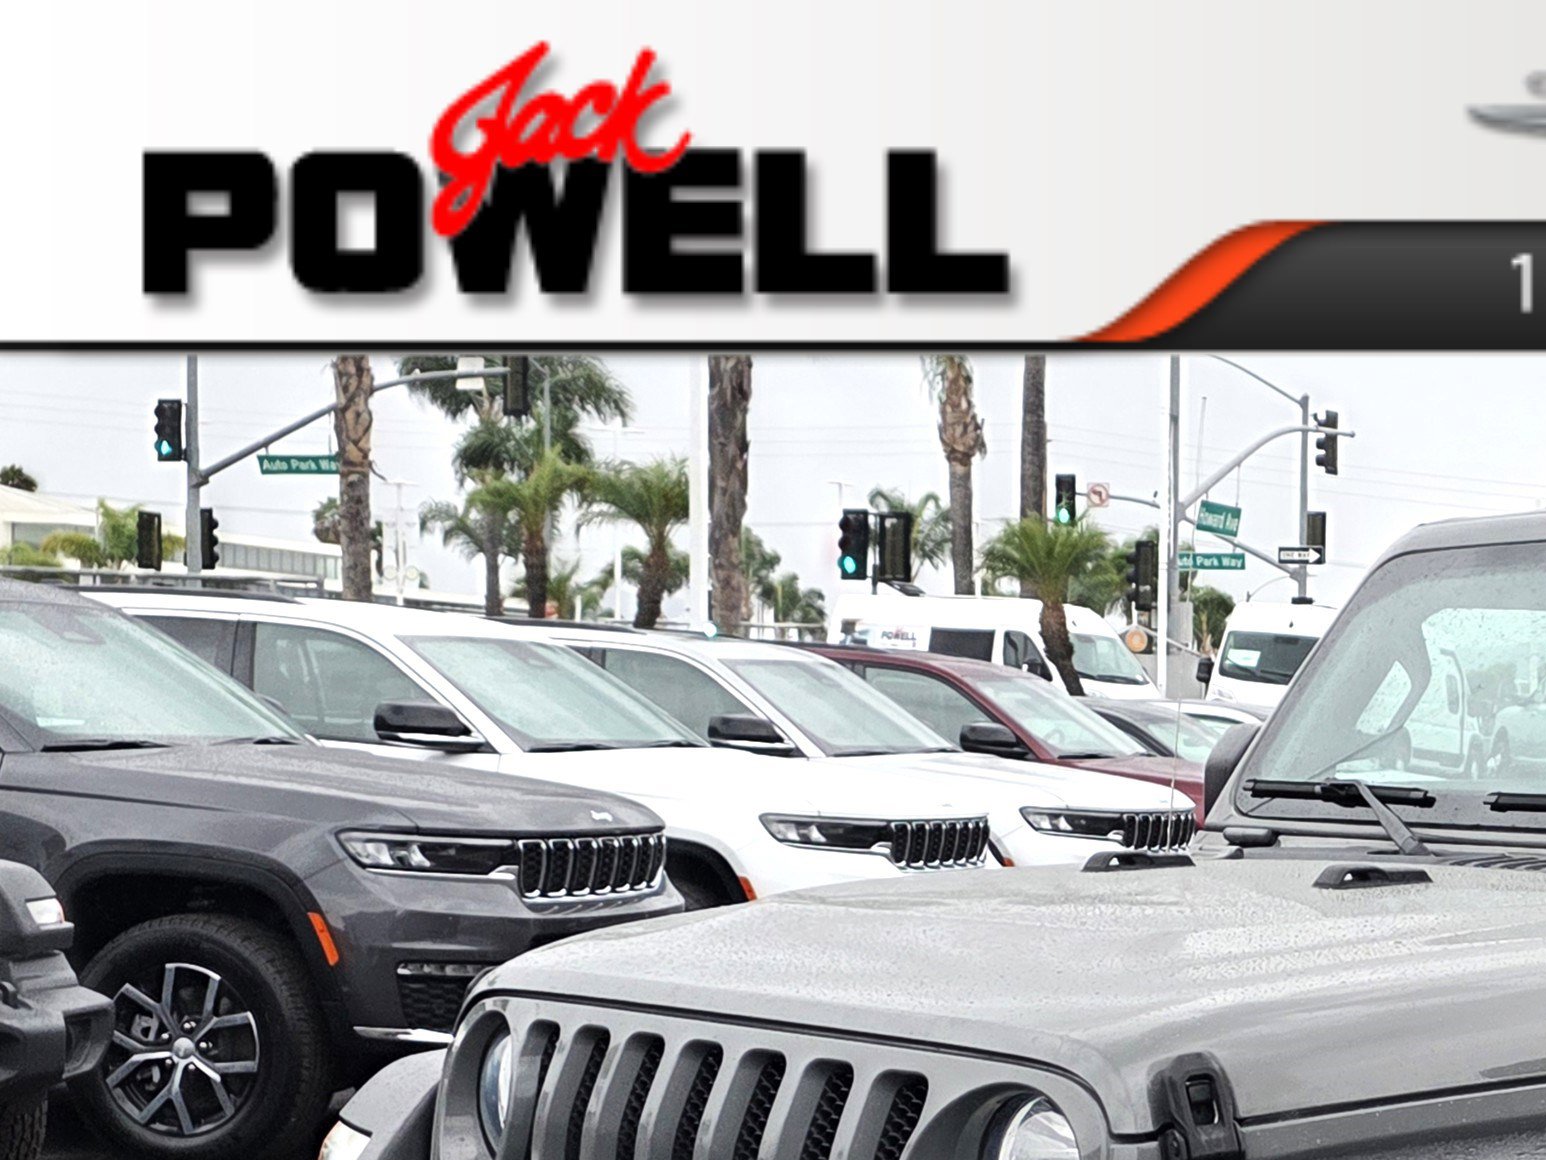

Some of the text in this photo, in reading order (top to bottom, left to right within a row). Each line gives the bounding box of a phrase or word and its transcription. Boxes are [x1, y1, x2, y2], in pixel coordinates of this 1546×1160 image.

[262, 458, 289, 471] Auto
[290, 458, 318, 471] Park
[1195, 555, 1219, 567] Park
[1221, 555, 1243, 568] Way
